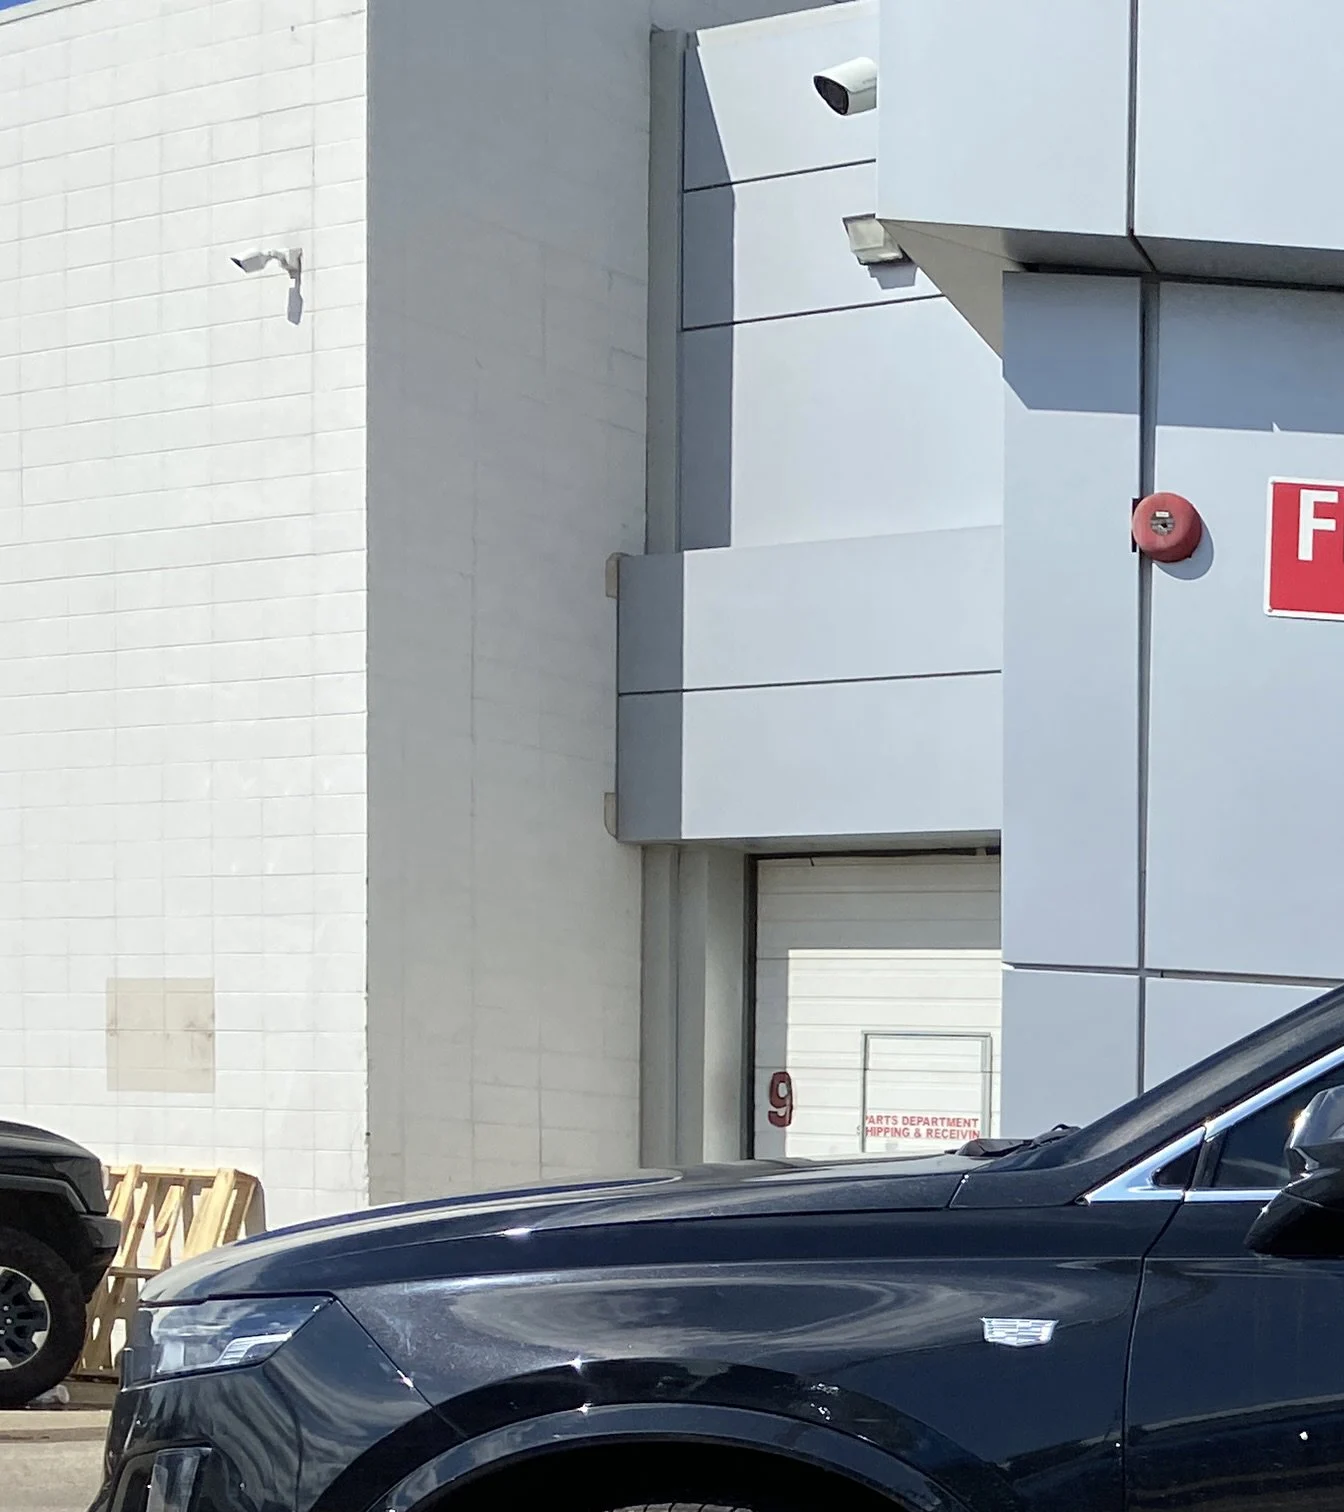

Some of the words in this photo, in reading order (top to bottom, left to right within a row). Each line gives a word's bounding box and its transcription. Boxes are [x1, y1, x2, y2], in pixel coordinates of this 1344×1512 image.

[768, 1071, 794, 1128] 9
[902, 1116, 979, 1128] DEPARTMENT
[926, 1128, 981, 1139] RECEIVIN
